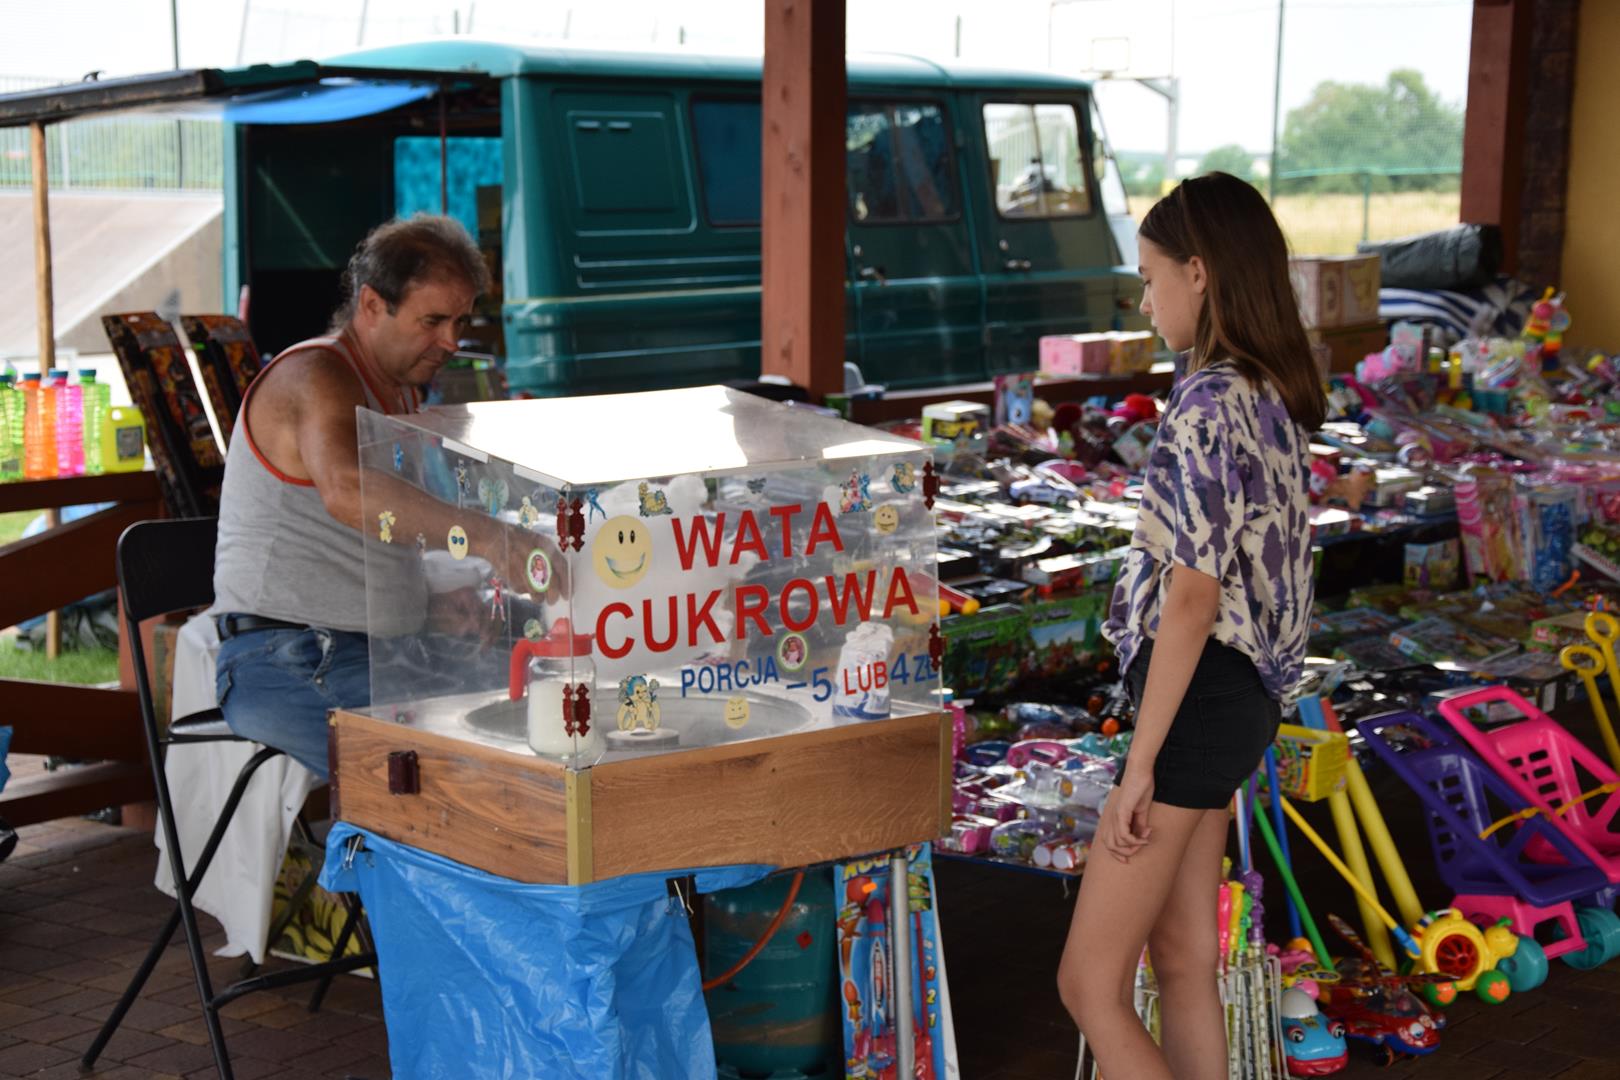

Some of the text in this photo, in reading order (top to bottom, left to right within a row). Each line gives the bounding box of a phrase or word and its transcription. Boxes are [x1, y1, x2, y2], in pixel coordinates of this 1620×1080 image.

[671, 501, 844, 571] WATA
[595, 566, 919, 659] CUKROWA
[681, 655, 779, 698] PORCJA
[843, 661, 889, 695] LUB
[890, 652, 910, 685] 4
